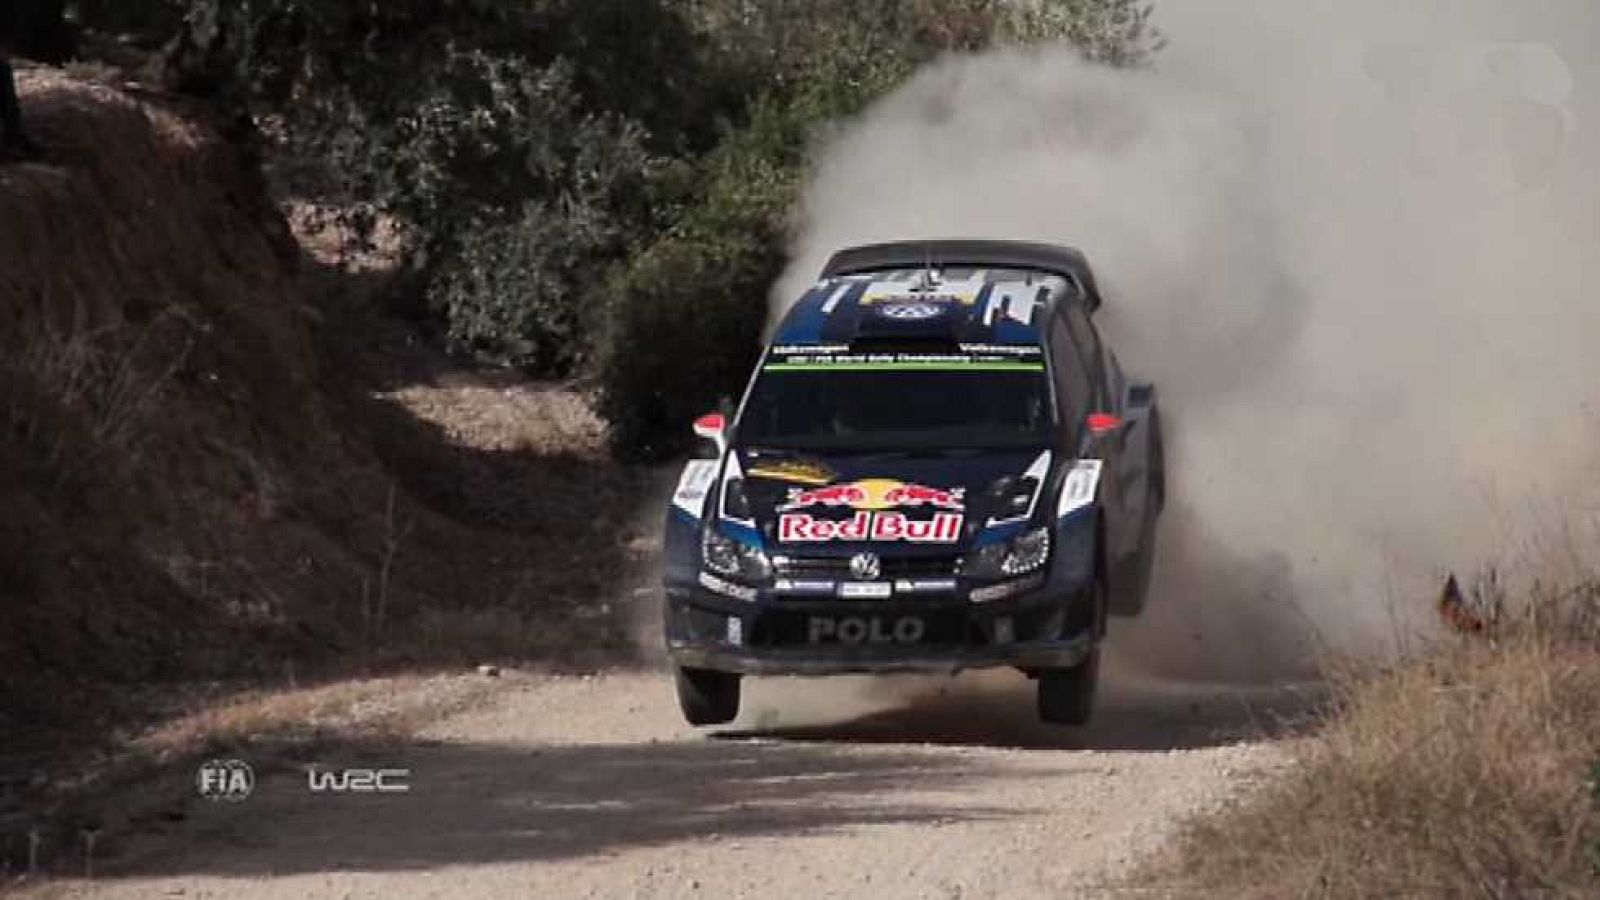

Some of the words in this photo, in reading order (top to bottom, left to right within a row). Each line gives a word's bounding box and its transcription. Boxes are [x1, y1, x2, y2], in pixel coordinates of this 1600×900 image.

[779, 511, 871, 542] Red
[871, 510, 963, 542] Bull
[809, 617, 925, 642] POLO
